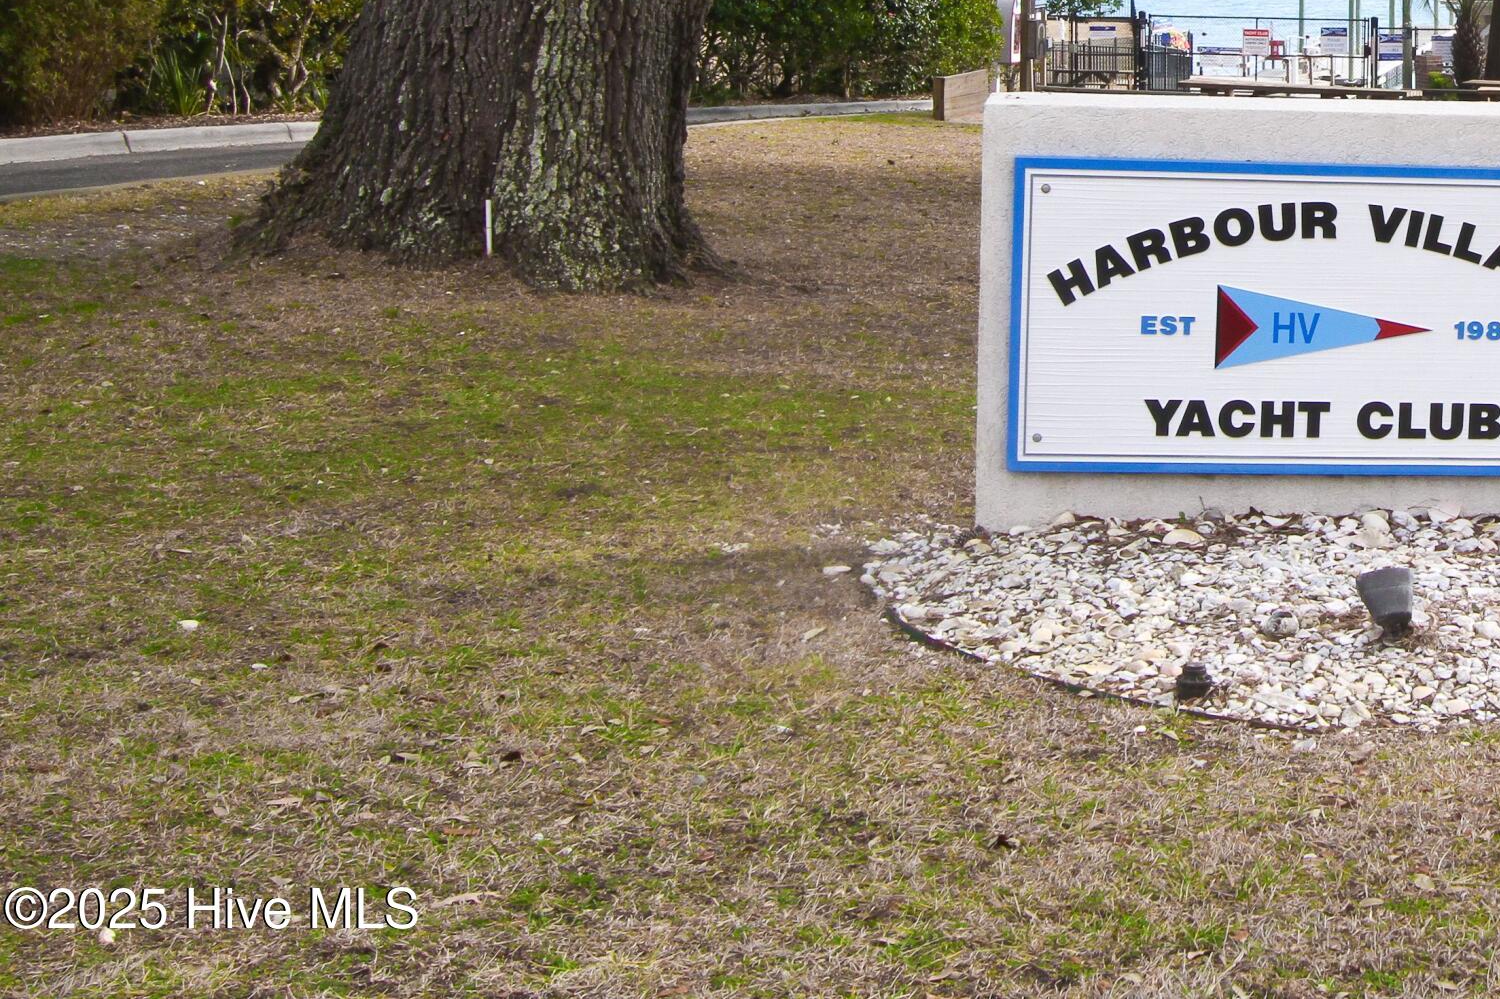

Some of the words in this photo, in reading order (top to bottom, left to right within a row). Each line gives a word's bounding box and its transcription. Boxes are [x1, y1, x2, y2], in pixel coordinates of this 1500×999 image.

[1046, 201, 1338, 307] HARBOUR
[1140, 315, 1196, 335] EST
[1272, 311, 1321, 345] HV
[1144, 398, 1331, 438] YACHT
